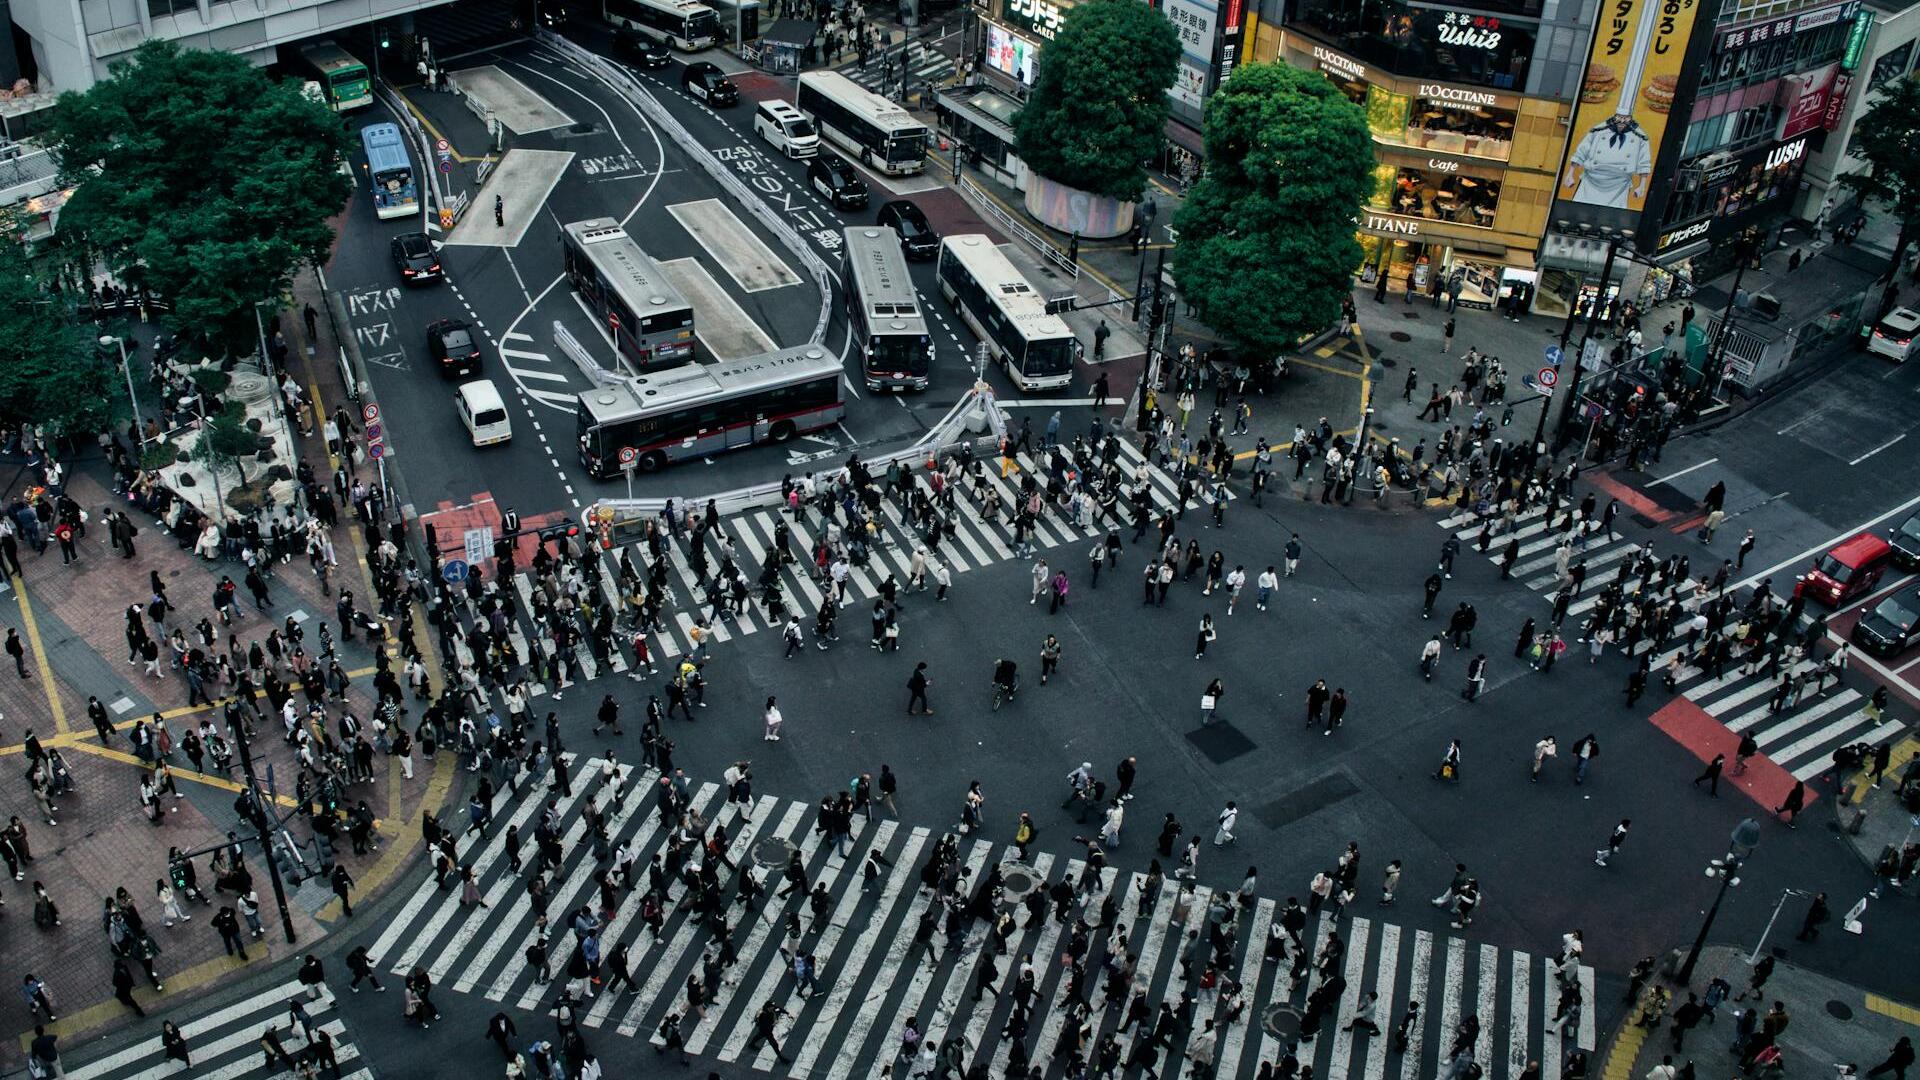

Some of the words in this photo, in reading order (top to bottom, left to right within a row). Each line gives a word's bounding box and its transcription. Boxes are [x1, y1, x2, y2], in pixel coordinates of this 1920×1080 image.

[1438, 24, 1502, 50] Ushi8
[1313, 46, 1366, 77] L'OCCITANE
[1419, 84, 1496, 105] L'OCCITANE
[1765, 138, 1806, 171] LUSH
